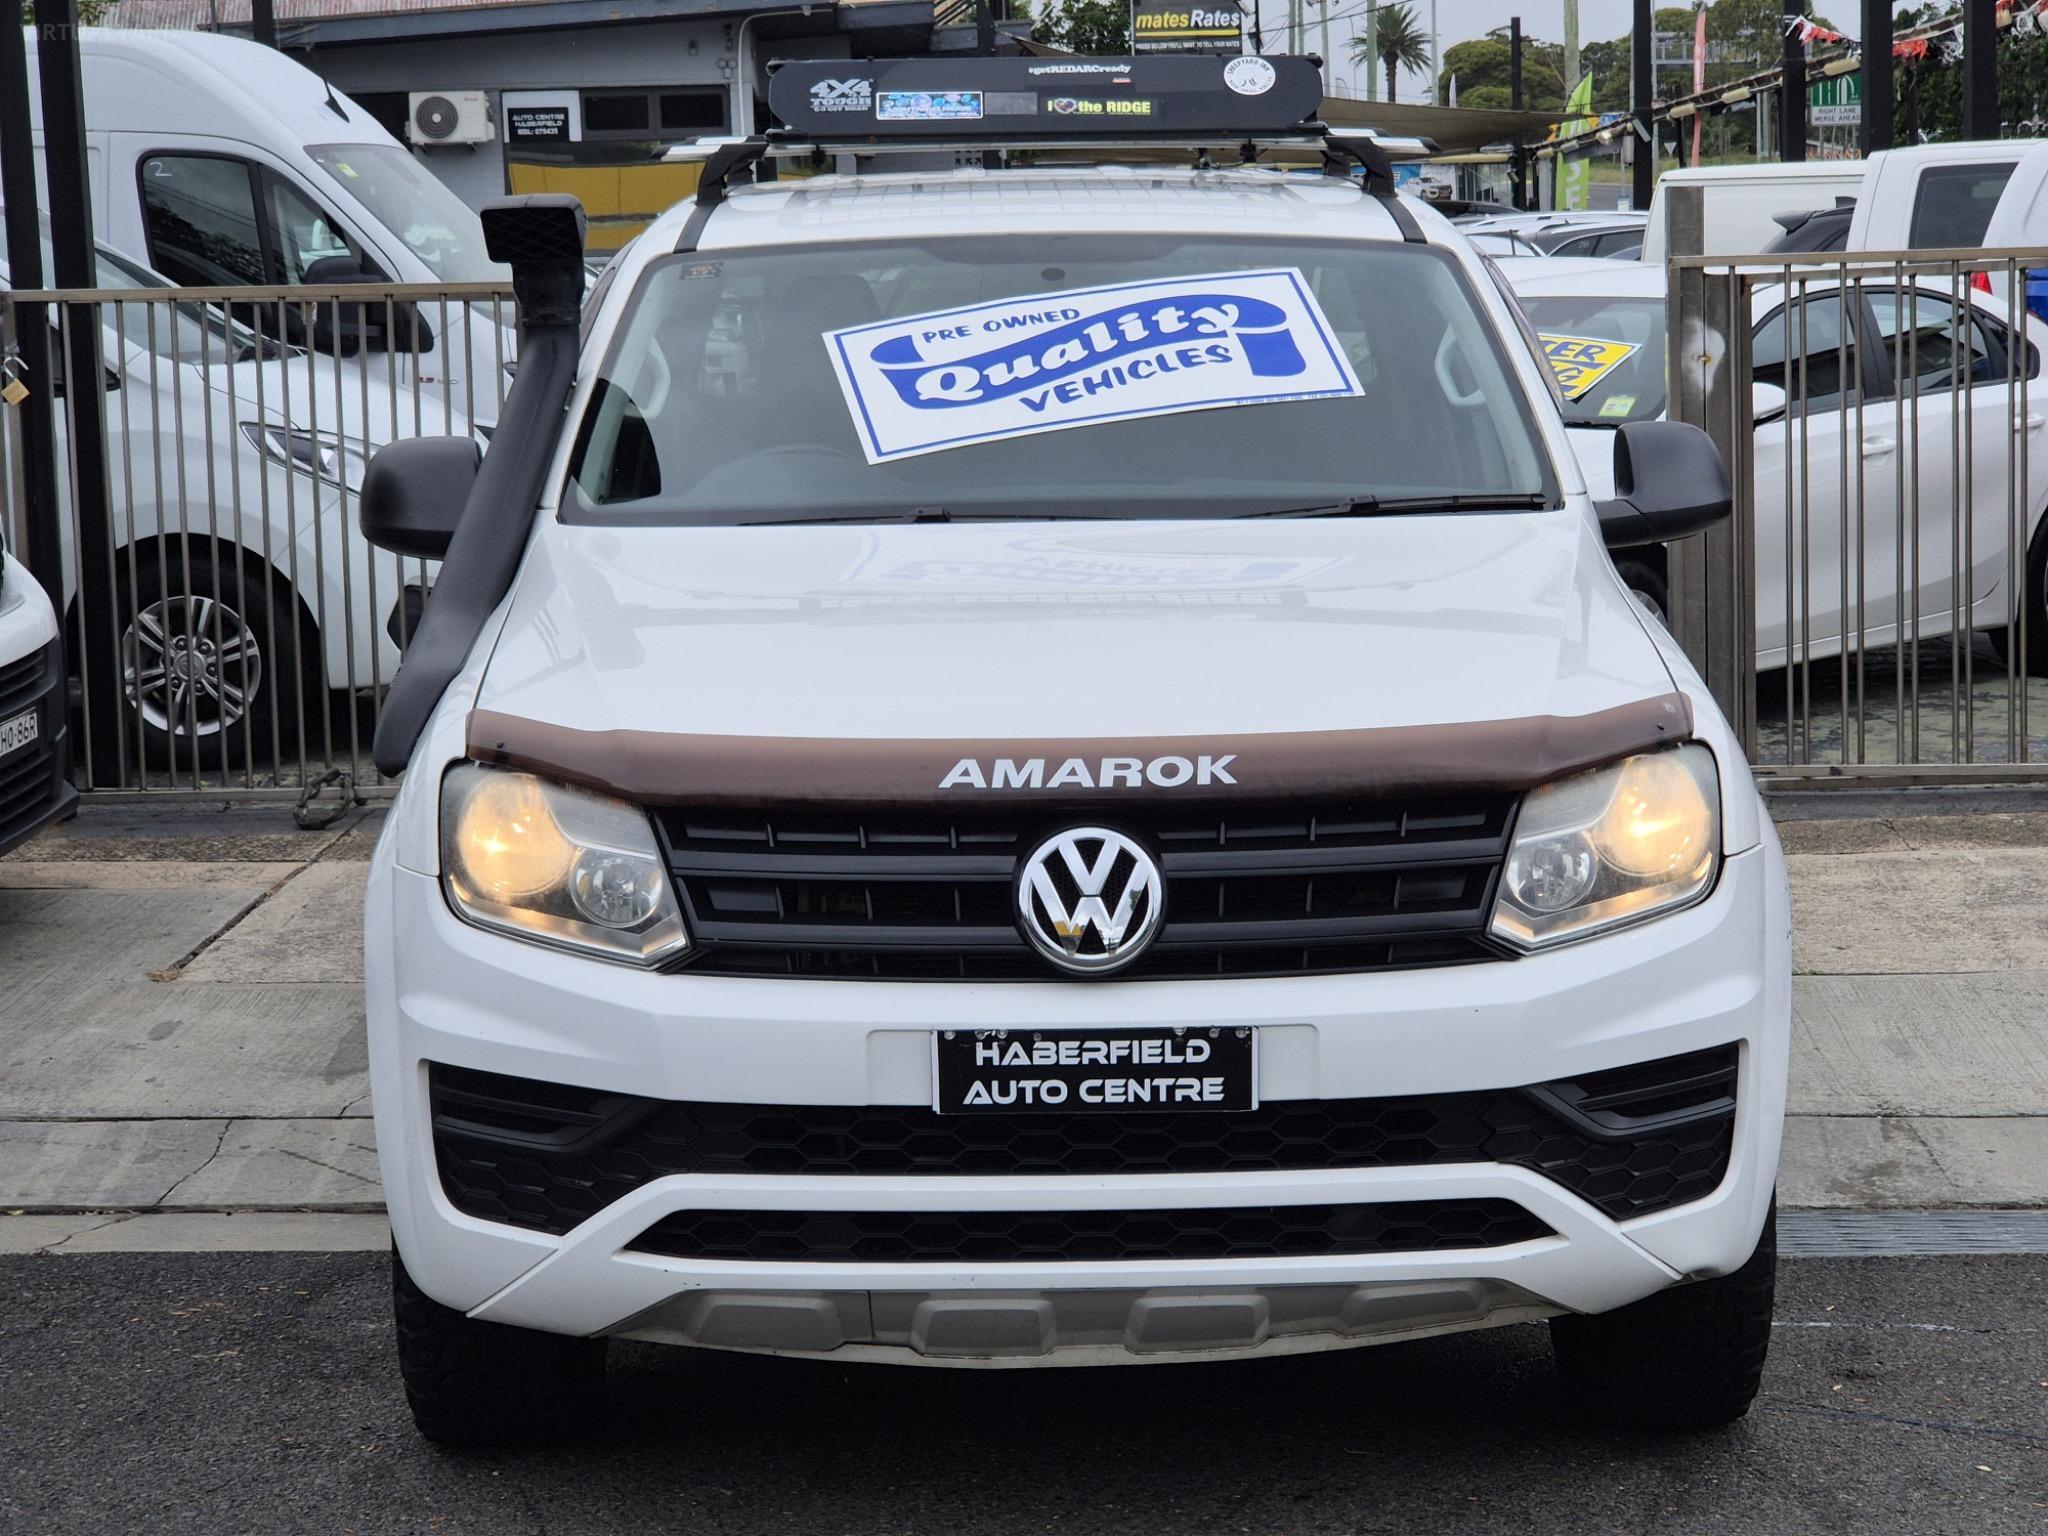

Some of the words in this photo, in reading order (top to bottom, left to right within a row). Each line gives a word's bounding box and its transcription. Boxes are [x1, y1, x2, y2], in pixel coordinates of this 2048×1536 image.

[1078, 101, 1102, 112] the
[1106, 101, 1151, 113] RIDGE
[149, 161, 173, 177] 2
[922, 326, 971, 344] PRE
[981, 308, 1082, 333] OWNED
[915, 302, 1241, 402] Quality
[1018, 343, 1234, 413] VEHICLES
[938, 755, 1238, 789] AMAROK
[975, 1038, 1212, 1067] HABERFIELD
[962, 1079, 1068, 1105] AUTO
[1079, 1076, 1226, 1105] CENTRE
